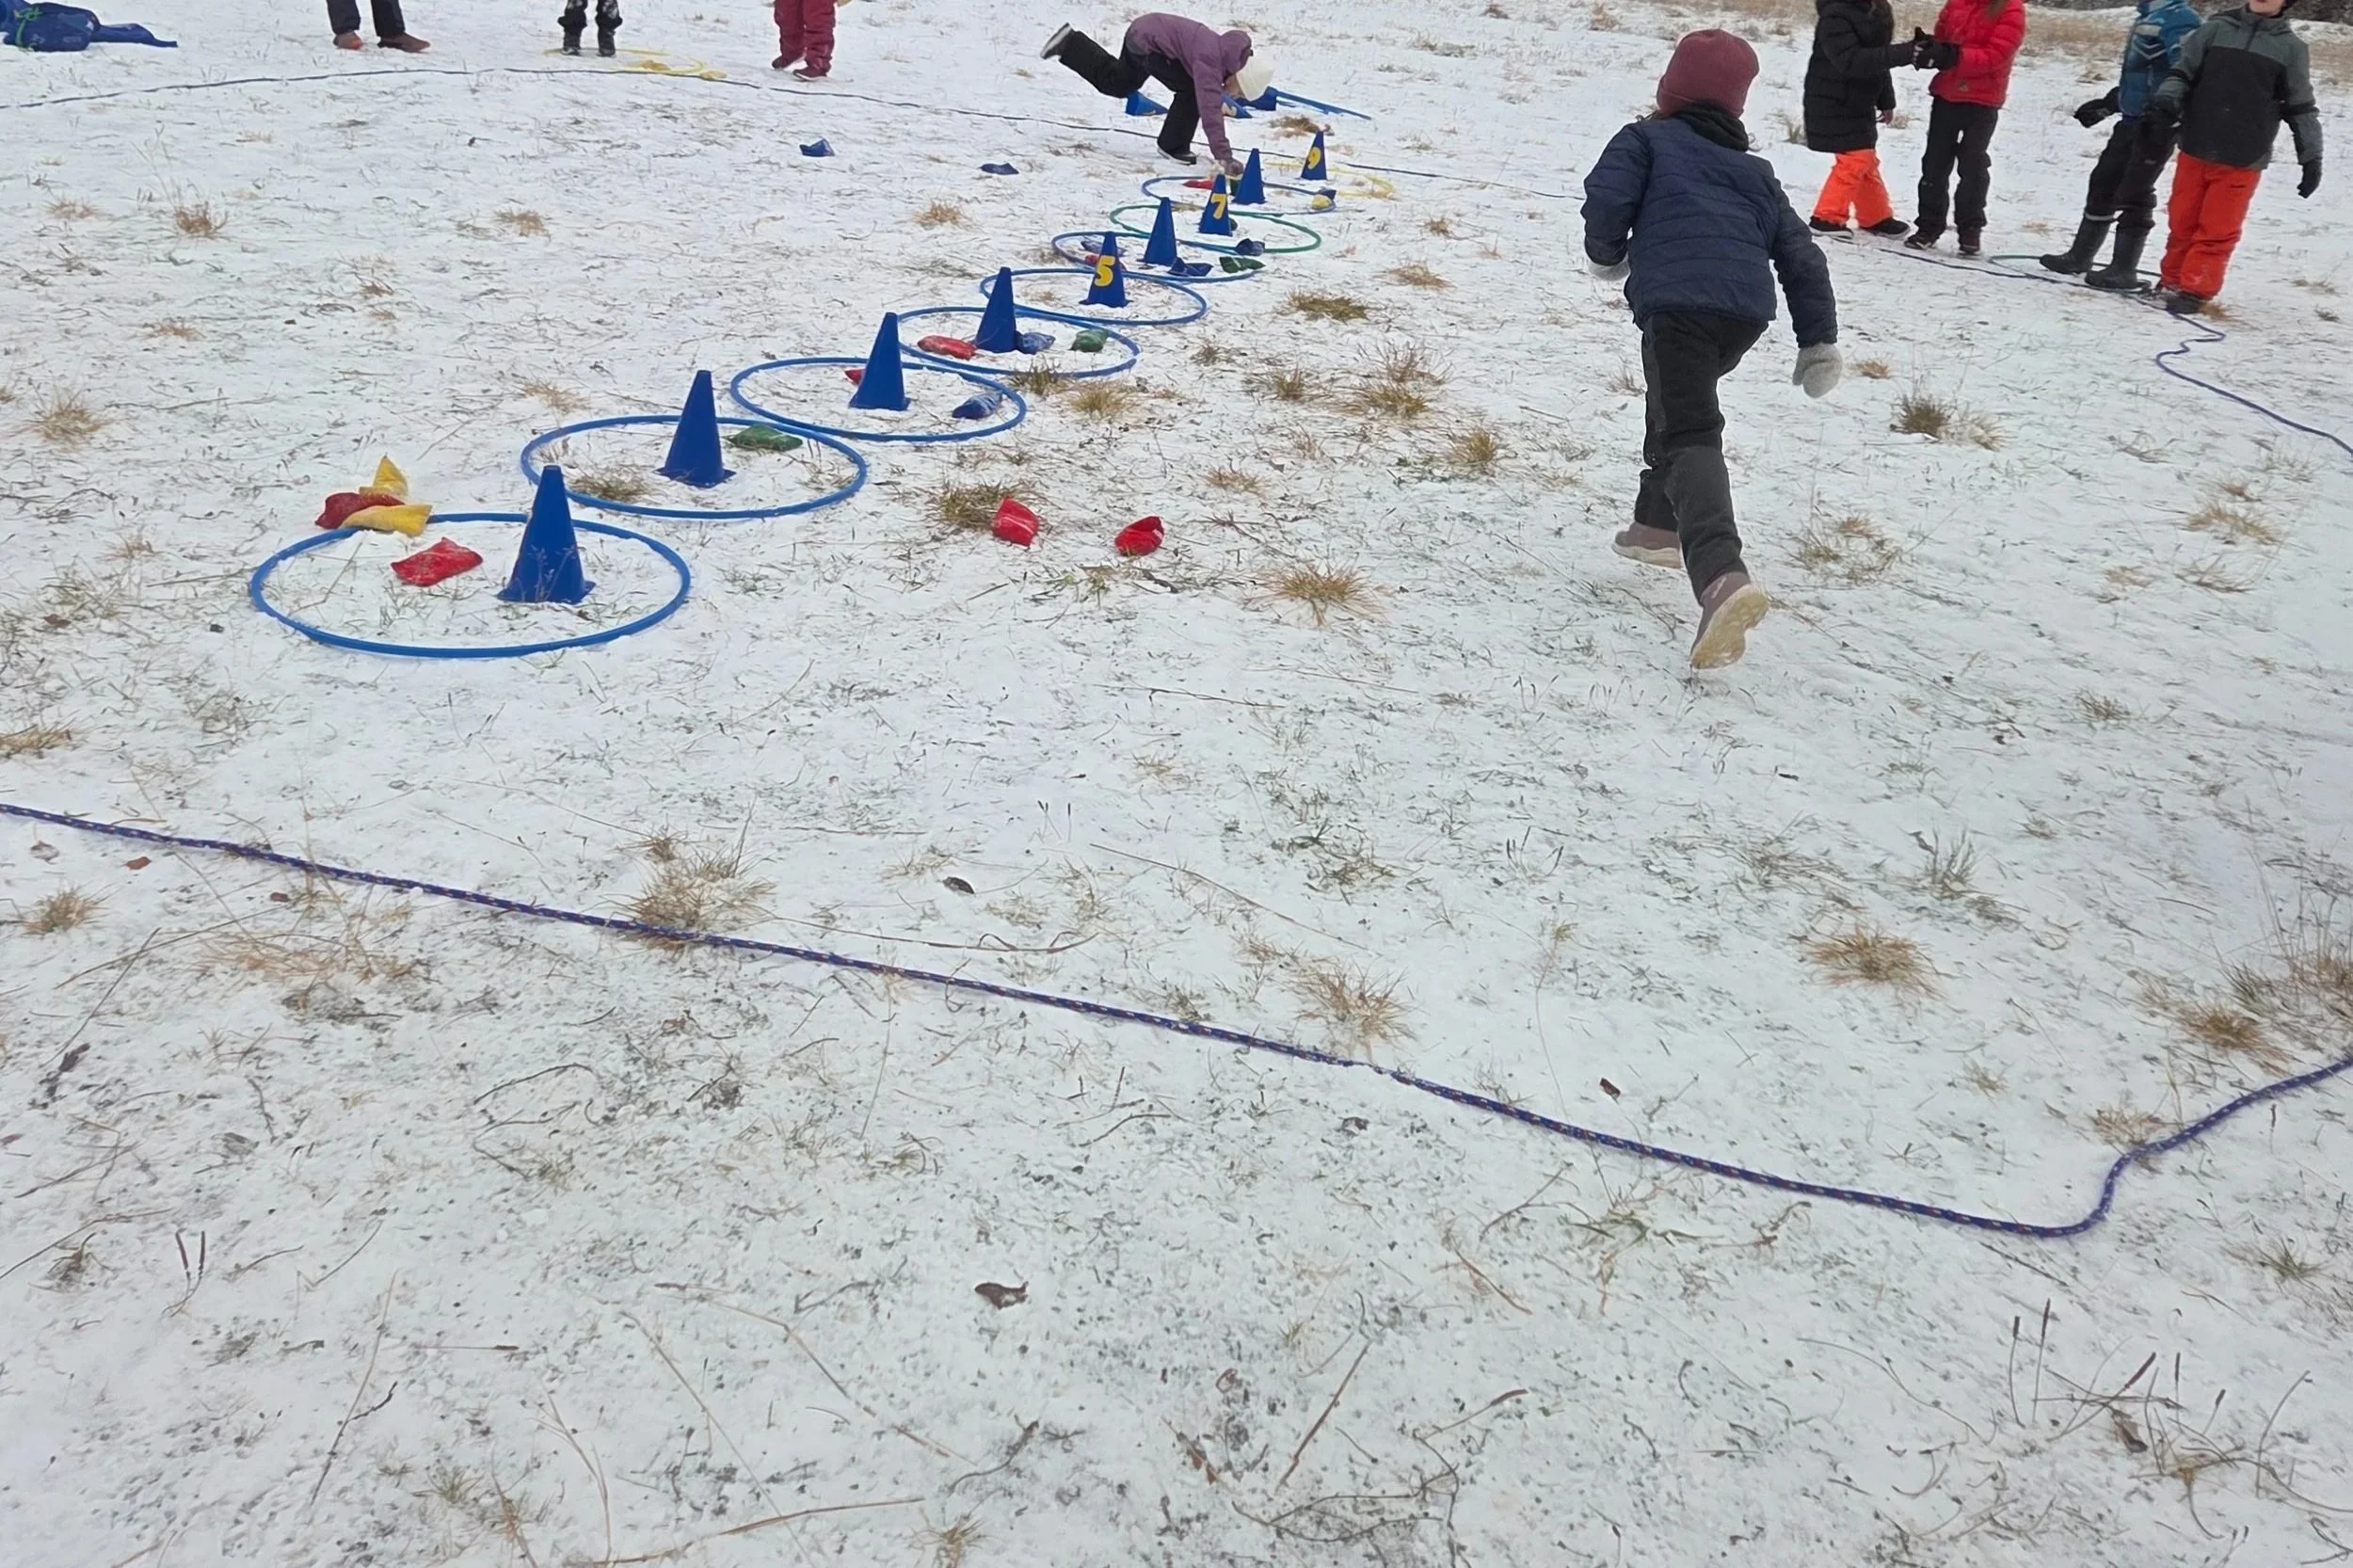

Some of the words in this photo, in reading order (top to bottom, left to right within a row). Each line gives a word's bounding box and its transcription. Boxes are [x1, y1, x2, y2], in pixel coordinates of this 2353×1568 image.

[1307, 146, 1321, 169] 9
[1211, 193, 1227, 219] 7
[1095, 255, 1116, 287] 5
